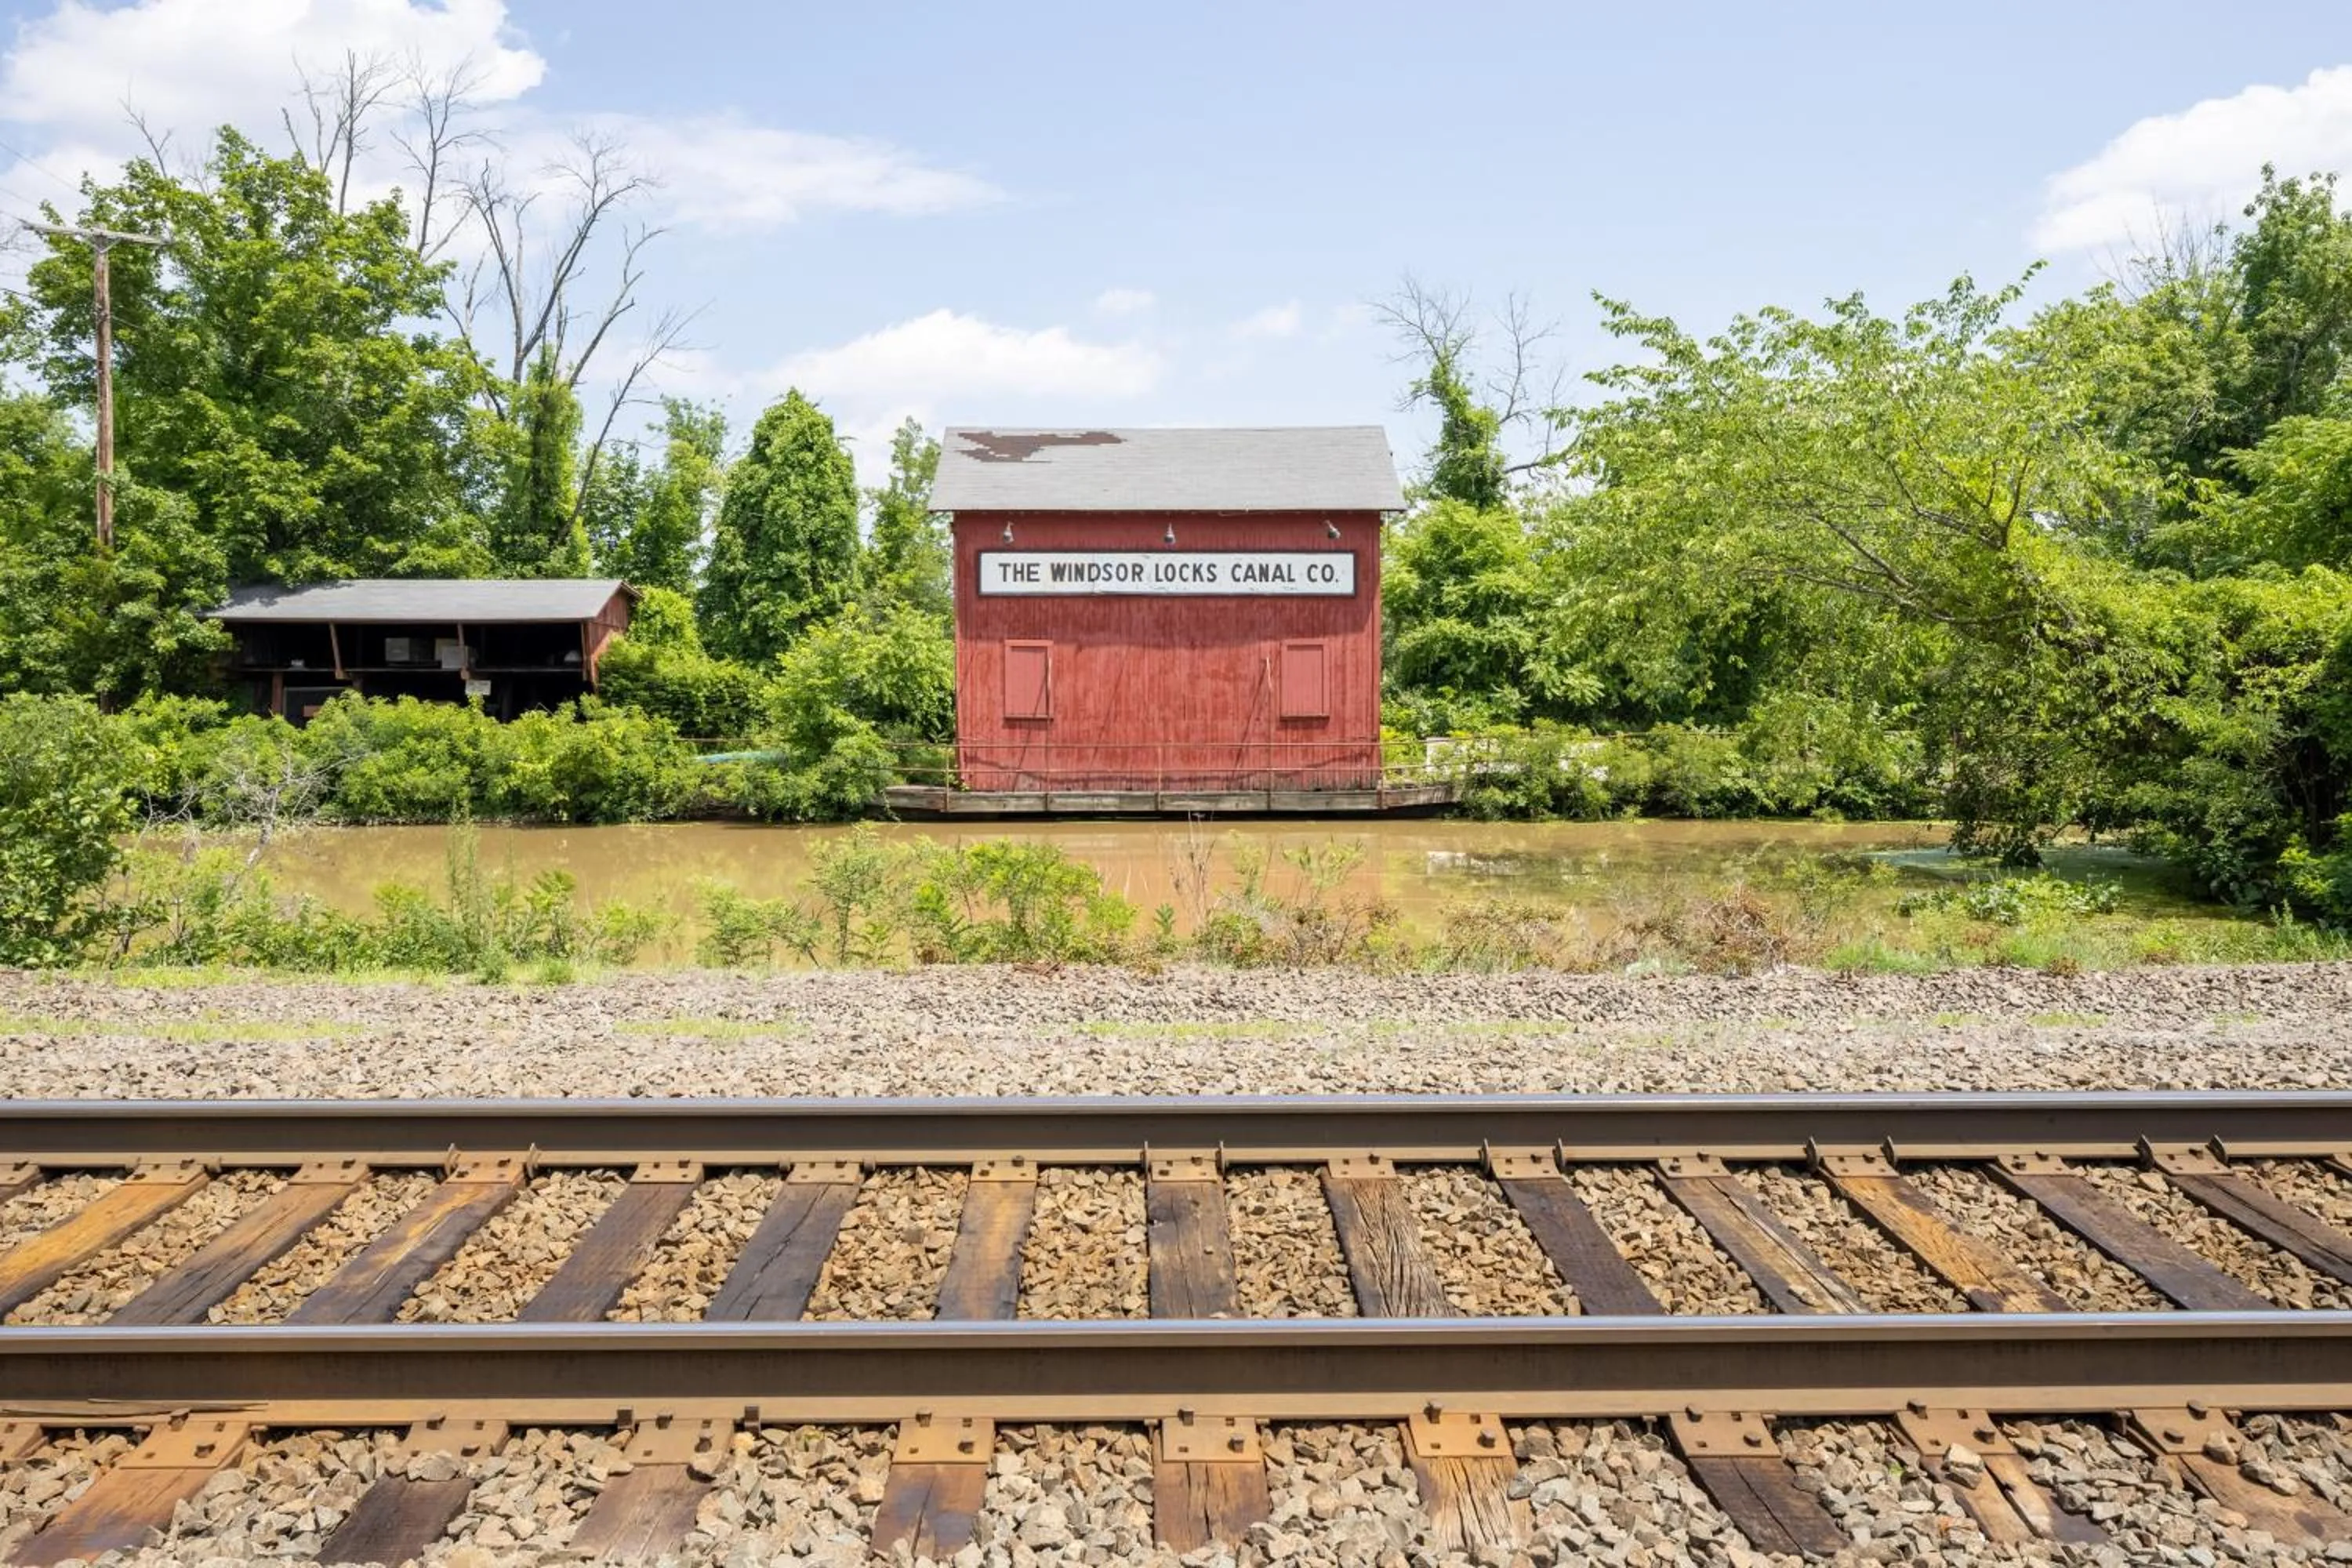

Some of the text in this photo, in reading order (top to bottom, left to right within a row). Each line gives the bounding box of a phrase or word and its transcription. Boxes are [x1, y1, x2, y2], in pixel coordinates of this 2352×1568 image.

[998, 562, 1339, 583] THE WINDSOR LOCKS CANAL CO.
